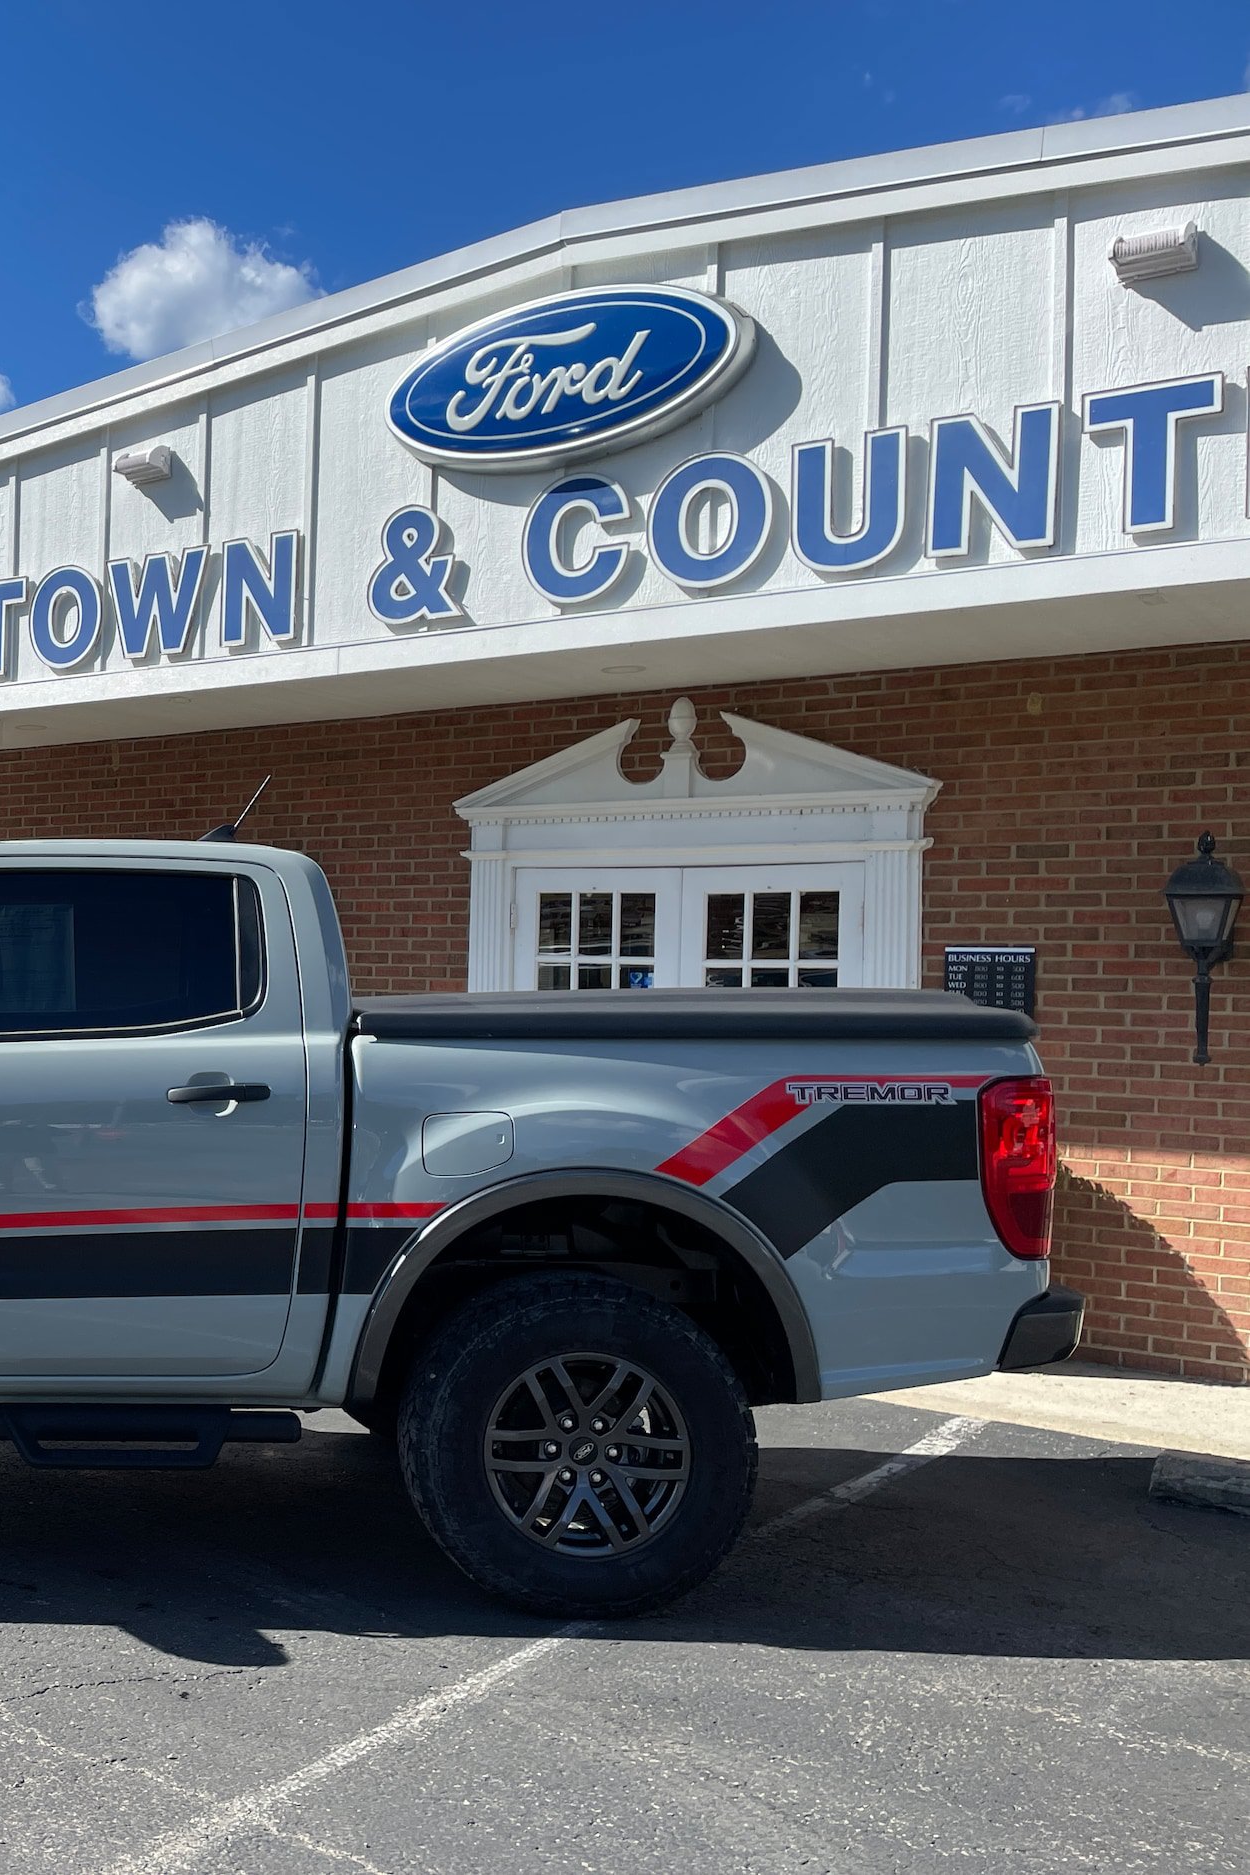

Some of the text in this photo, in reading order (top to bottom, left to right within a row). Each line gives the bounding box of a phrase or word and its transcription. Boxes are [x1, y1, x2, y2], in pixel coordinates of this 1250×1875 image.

[446, 322, 651, 433] Ford
[367, 504, 463, 625] &
[522, 364, 1250, 606] COUNT
[948, 954, 1031, 963] BUSINESS HOURS
[948, 981, 966, 989] WED
[787, 1082, 955, 1104] TREMOR
